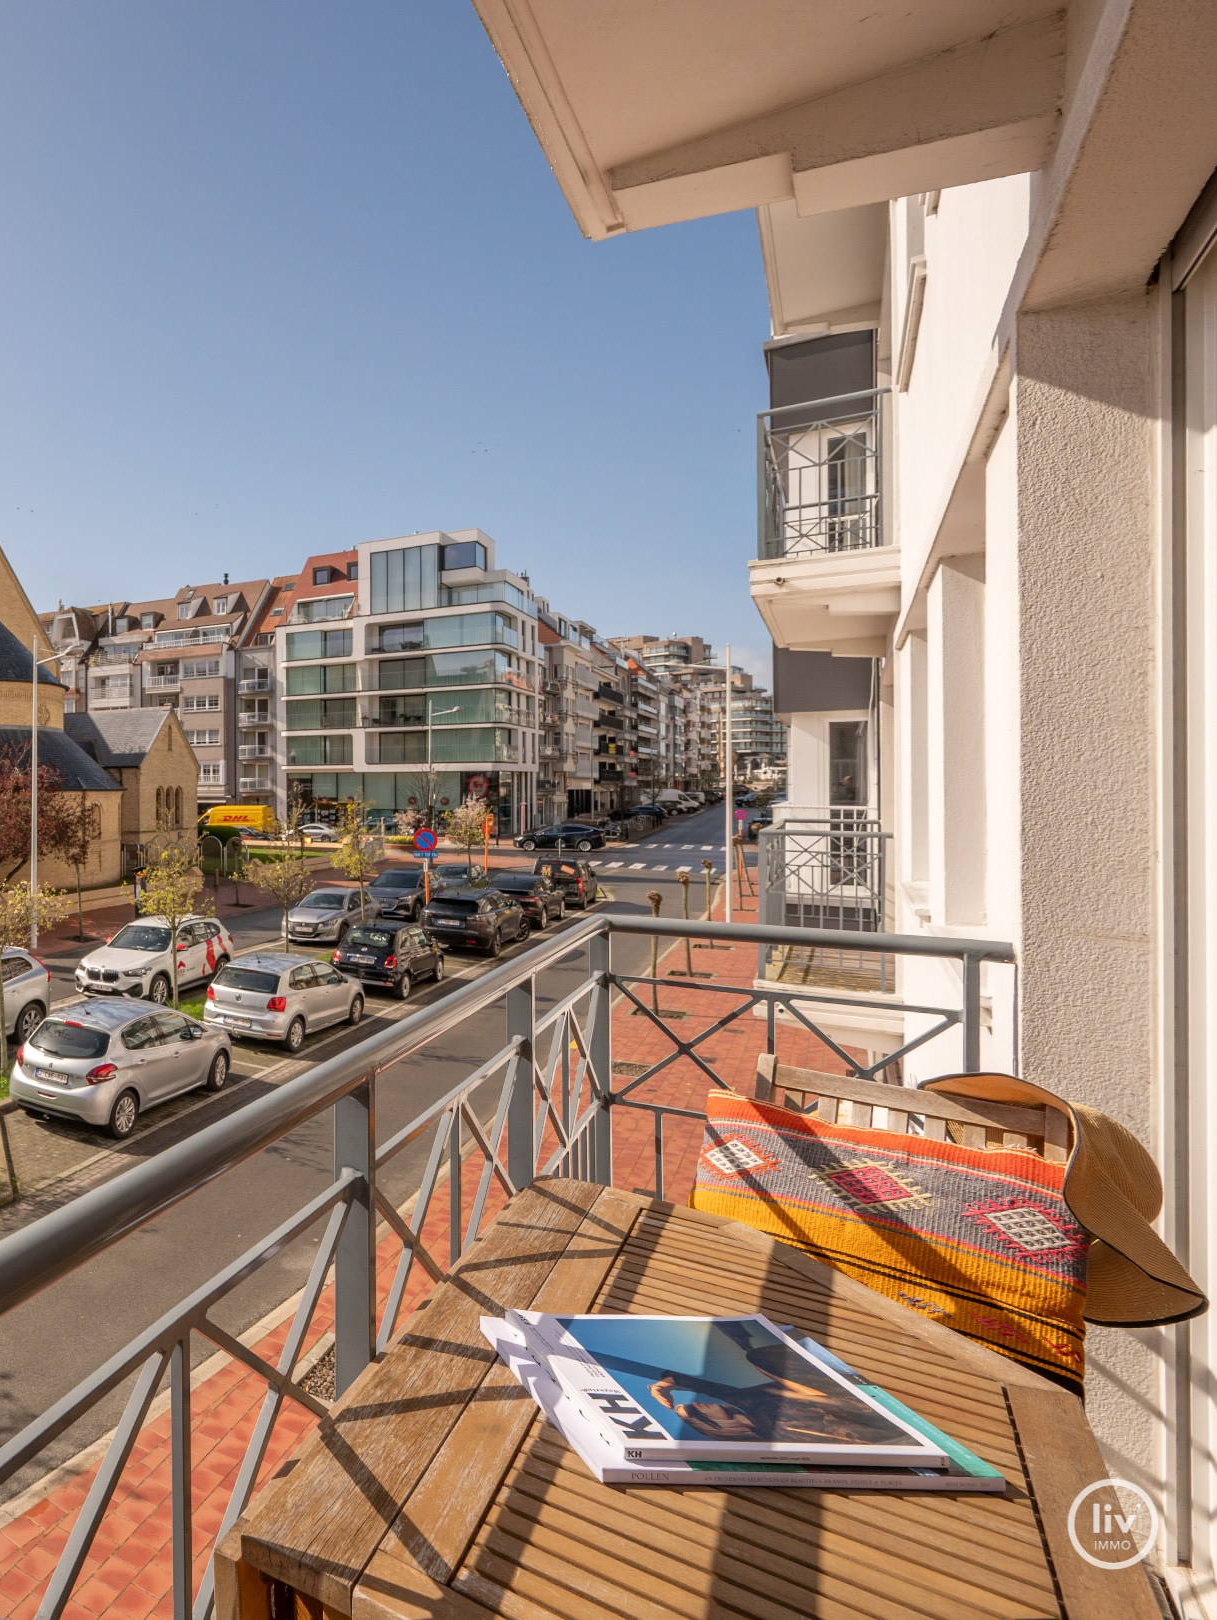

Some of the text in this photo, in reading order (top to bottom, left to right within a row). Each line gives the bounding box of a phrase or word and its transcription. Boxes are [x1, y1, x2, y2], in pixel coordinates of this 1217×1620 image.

[586, 1392, 669, 1440] KH
[627, 1450, 642, 1458] KH
[631, 1472, 670, 1481] POLLEN
